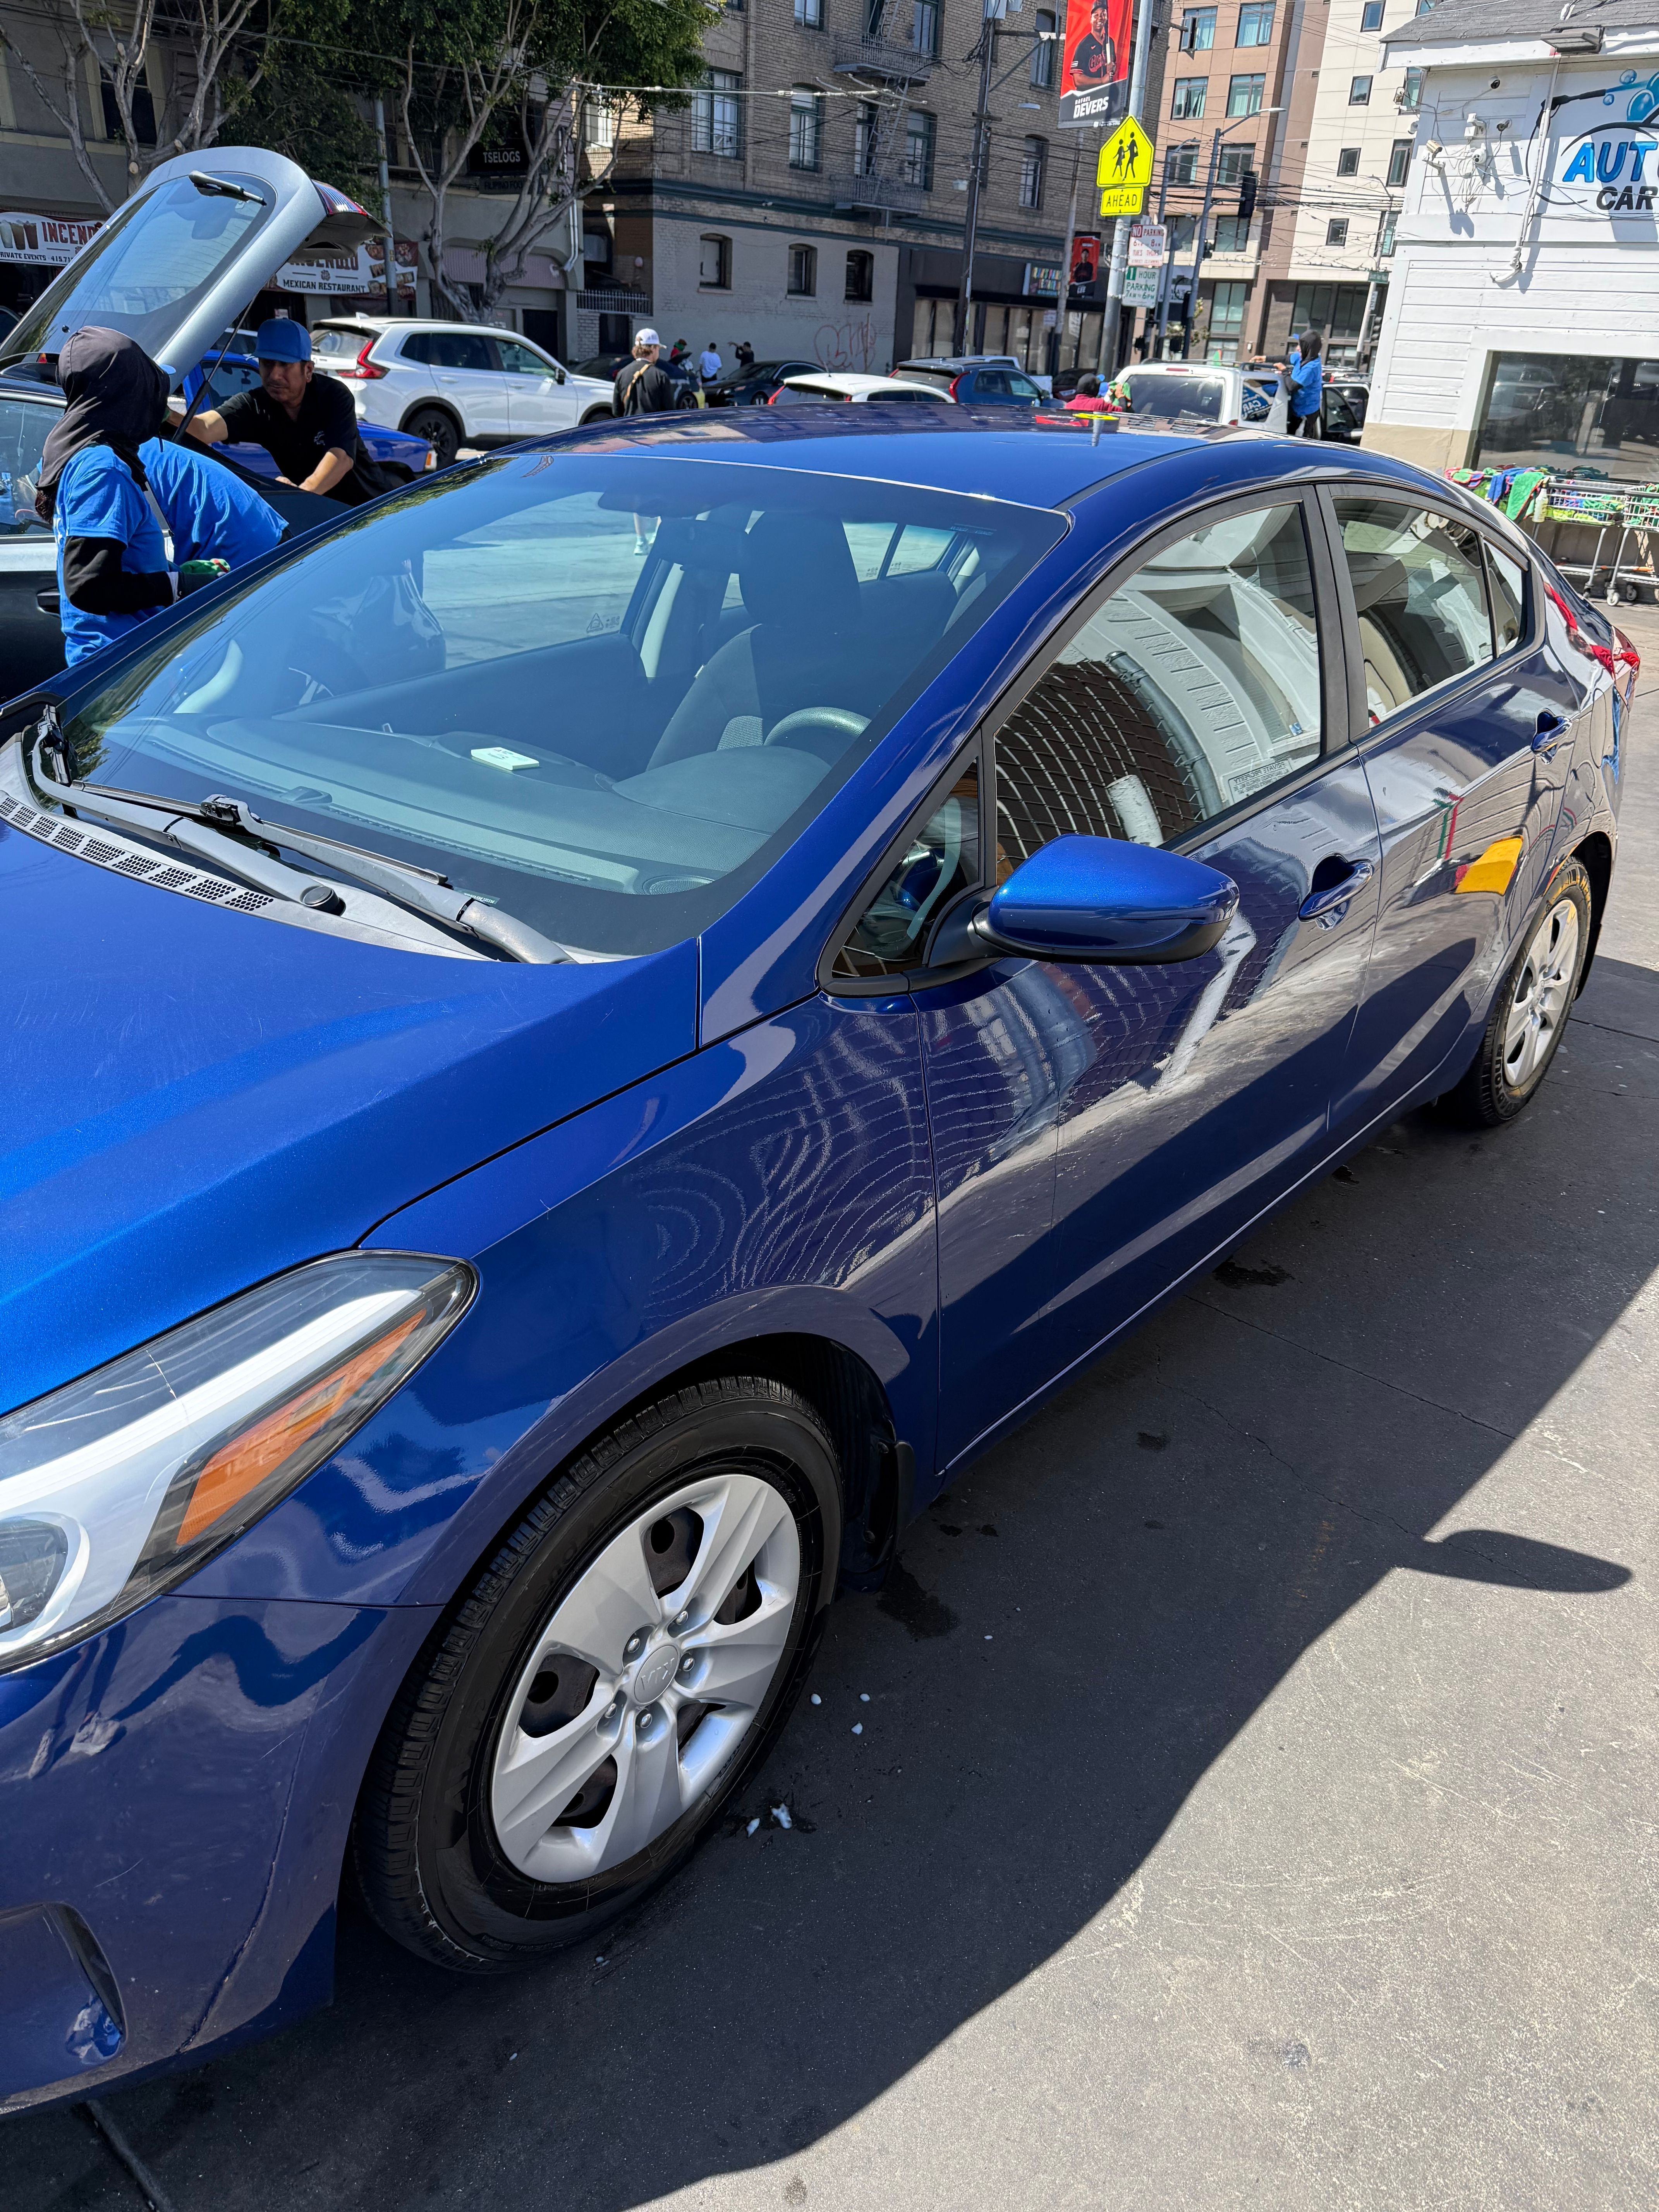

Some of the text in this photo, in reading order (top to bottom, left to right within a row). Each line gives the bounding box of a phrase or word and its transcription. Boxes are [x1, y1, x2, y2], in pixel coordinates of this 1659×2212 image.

[1073, 96, 1109, 119] DEVERS
[483, 151, 521, 163] TSELOGS
[1562, 141, 1659, 183] AUT
[1106, 194, 1137, 207] AHEAD
[1596, 186, 1659, 210] CAR
[41, 222, 97, 245] INCEND
[1132, 226, 1142, 237] NO
[283, 279, 366, 294] MEXICAN RESTAURANT
[1126, 282, 1155, 292] PARKING
